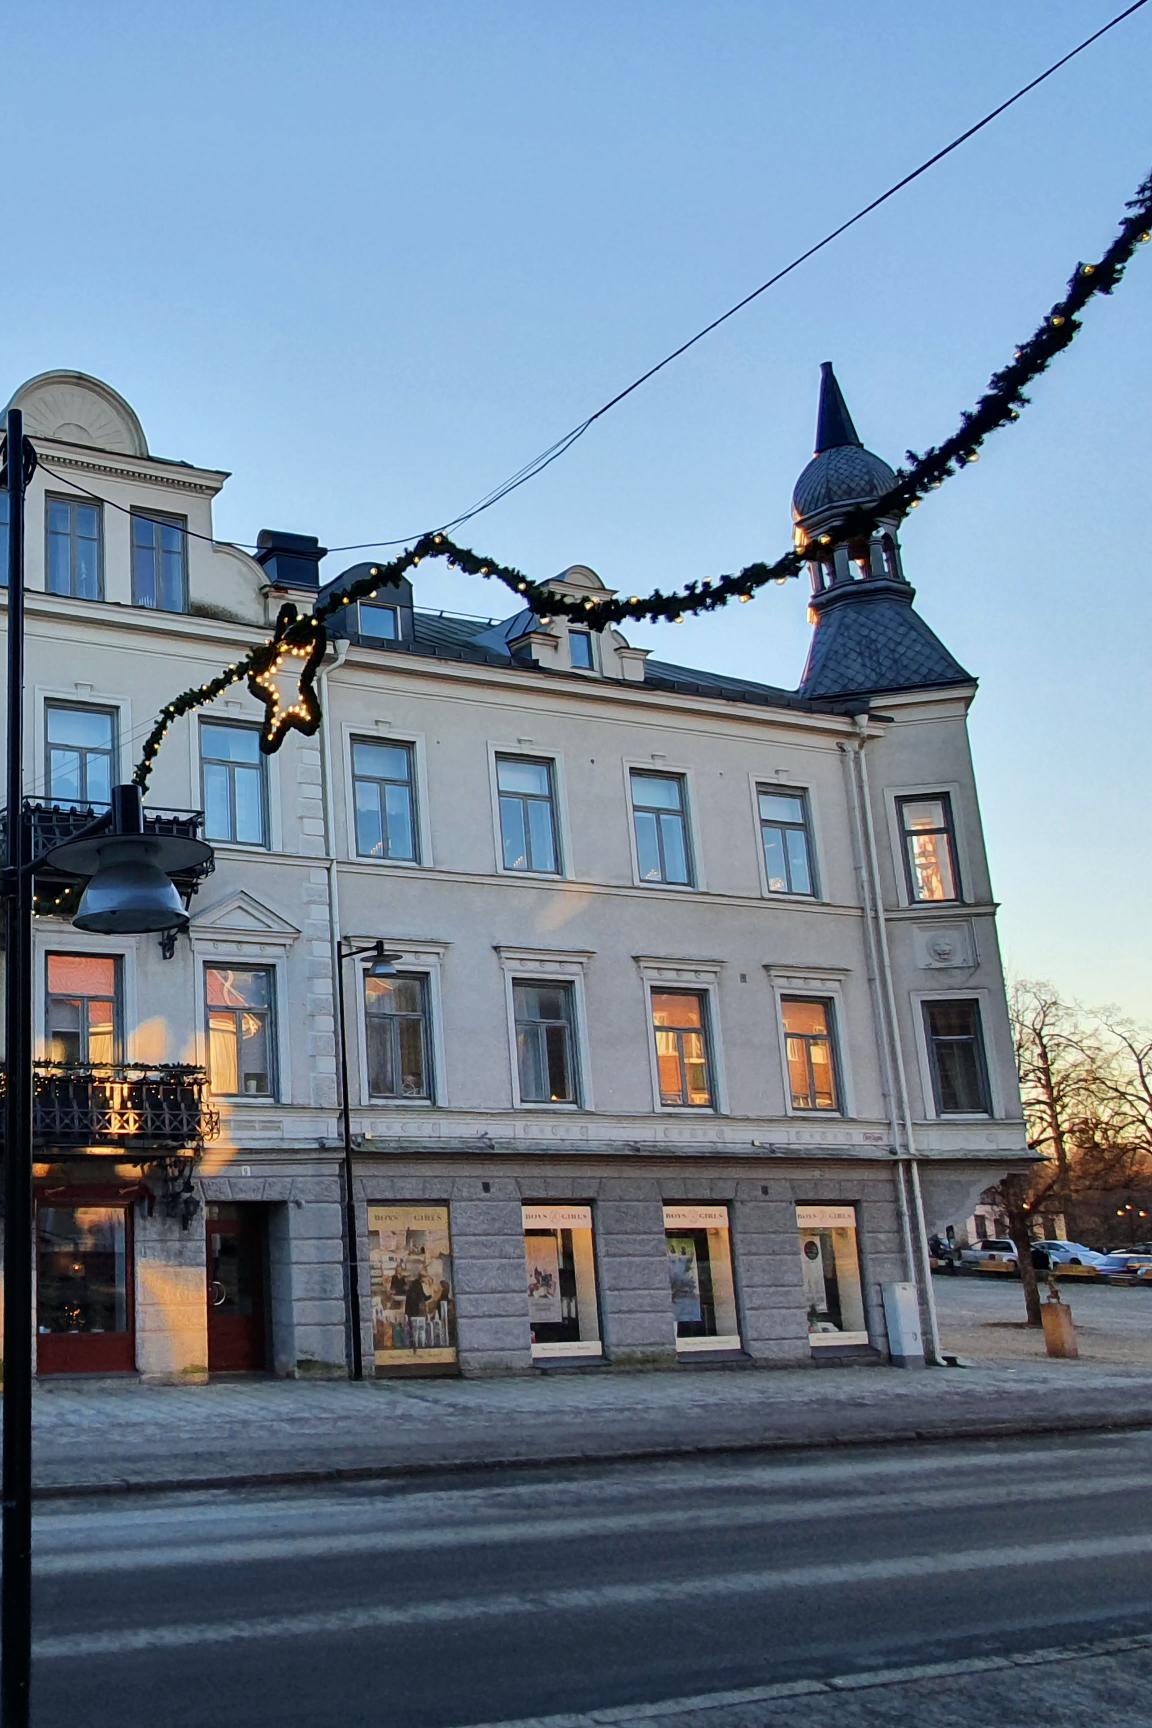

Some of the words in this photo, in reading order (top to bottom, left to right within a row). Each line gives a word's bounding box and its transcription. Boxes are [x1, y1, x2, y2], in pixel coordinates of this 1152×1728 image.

[373, 1213, 398, 1221] BOYS
[413, 1213, 442, 1221] GIRLS
[525, 1212, 548, 1220] BOYS
[561, 1212, 588, 1220] GIRLS
[665, 1212, 687, 1220] BOYS
[698, 1212, 724, 1220] GIRLS
